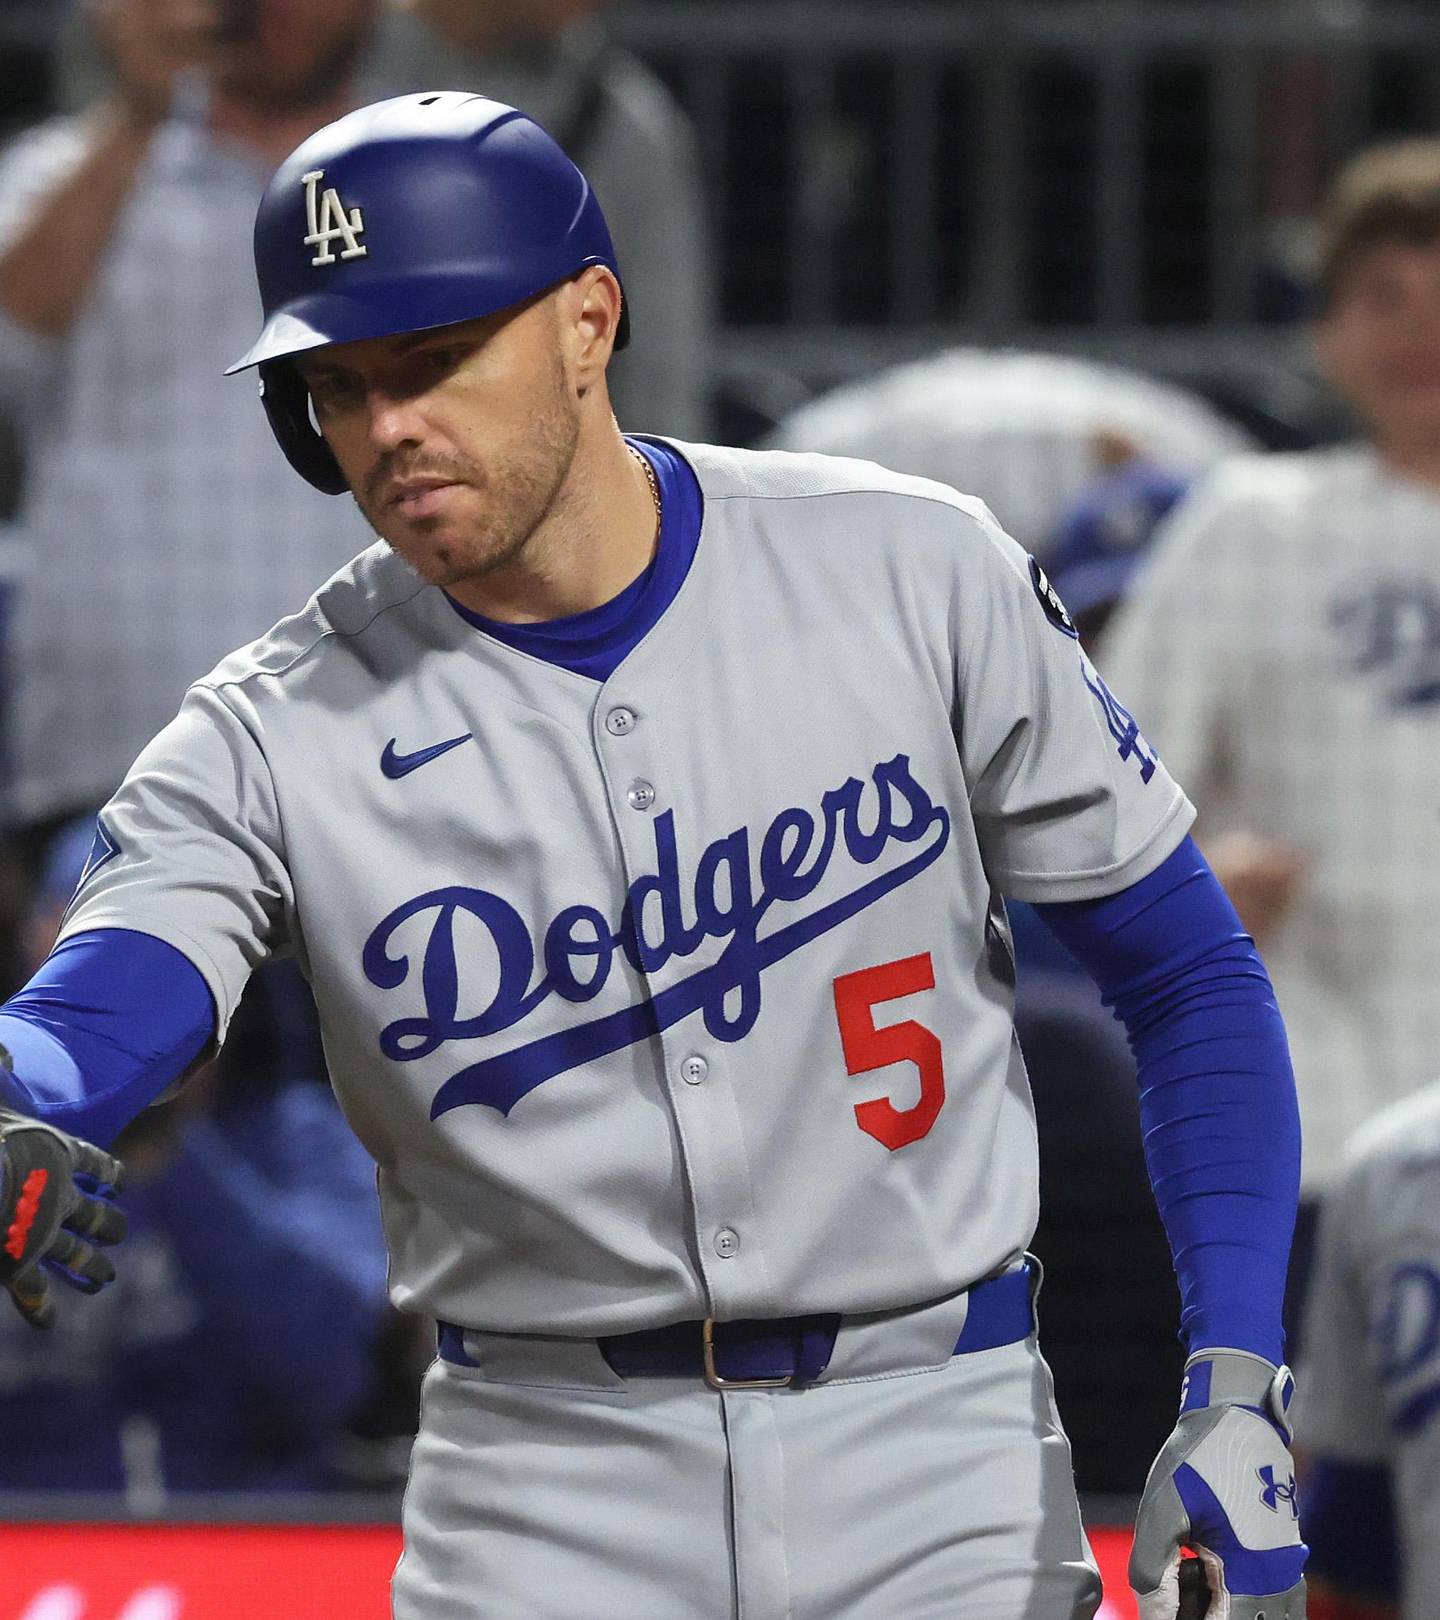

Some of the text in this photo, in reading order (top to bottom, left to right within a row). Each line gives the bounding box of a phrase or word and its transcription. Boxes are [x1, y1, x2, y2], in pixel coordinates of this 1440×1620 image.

[301, 169, 367, 266] LA
[362, 753, 950, 1062] Dodgers
[832, 951, 946, 1151] 5
